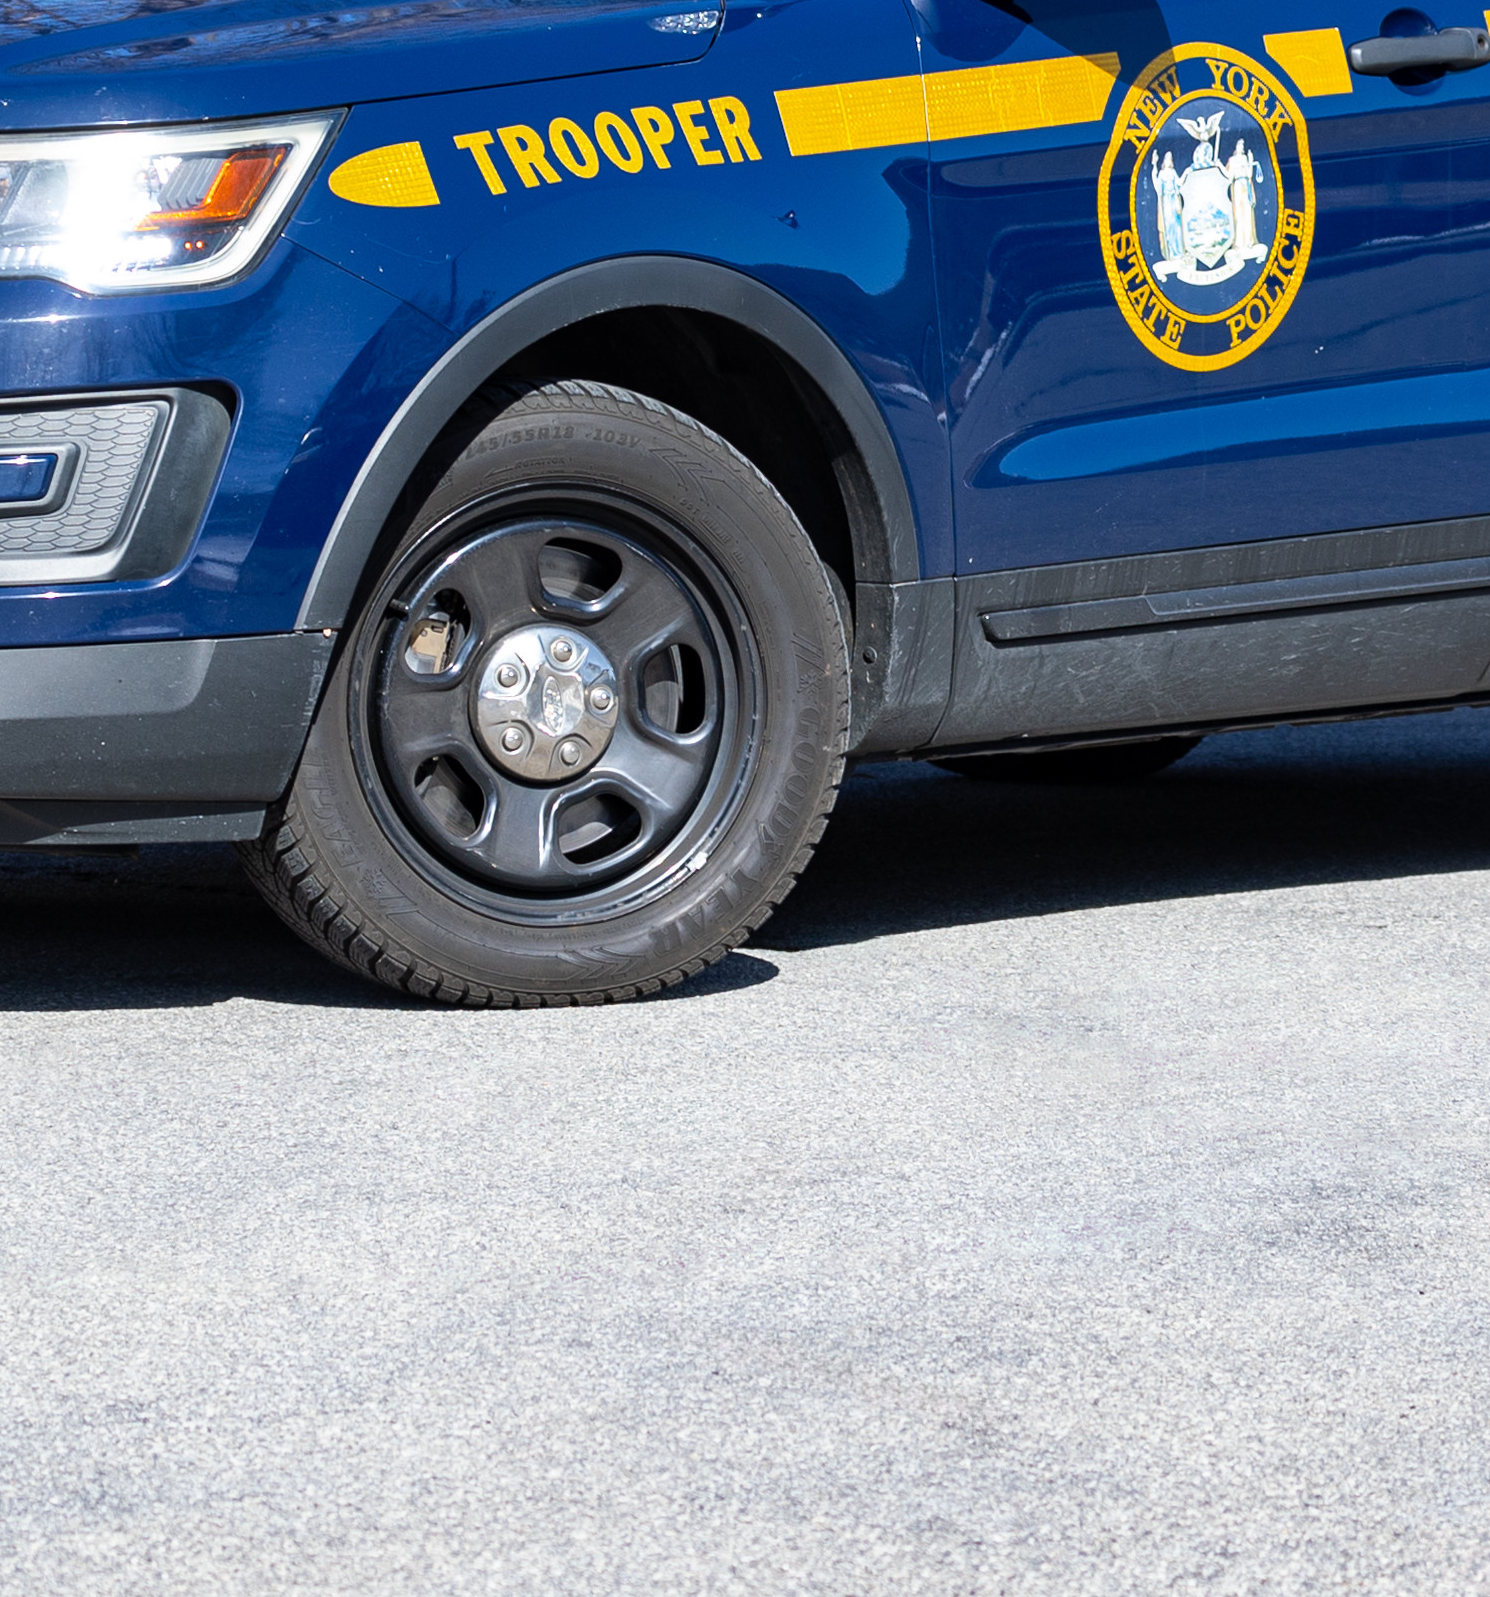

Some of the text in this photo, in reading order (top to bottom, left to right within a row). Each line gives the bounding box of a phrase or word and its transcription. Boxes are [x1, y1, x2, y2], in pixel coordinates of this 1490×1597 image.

[453, 95, 762, 196] TROOPER
[1123, 59, 1293, 155] NEW YORK
[1110, 208, 1305, 350] STATE POLICE
